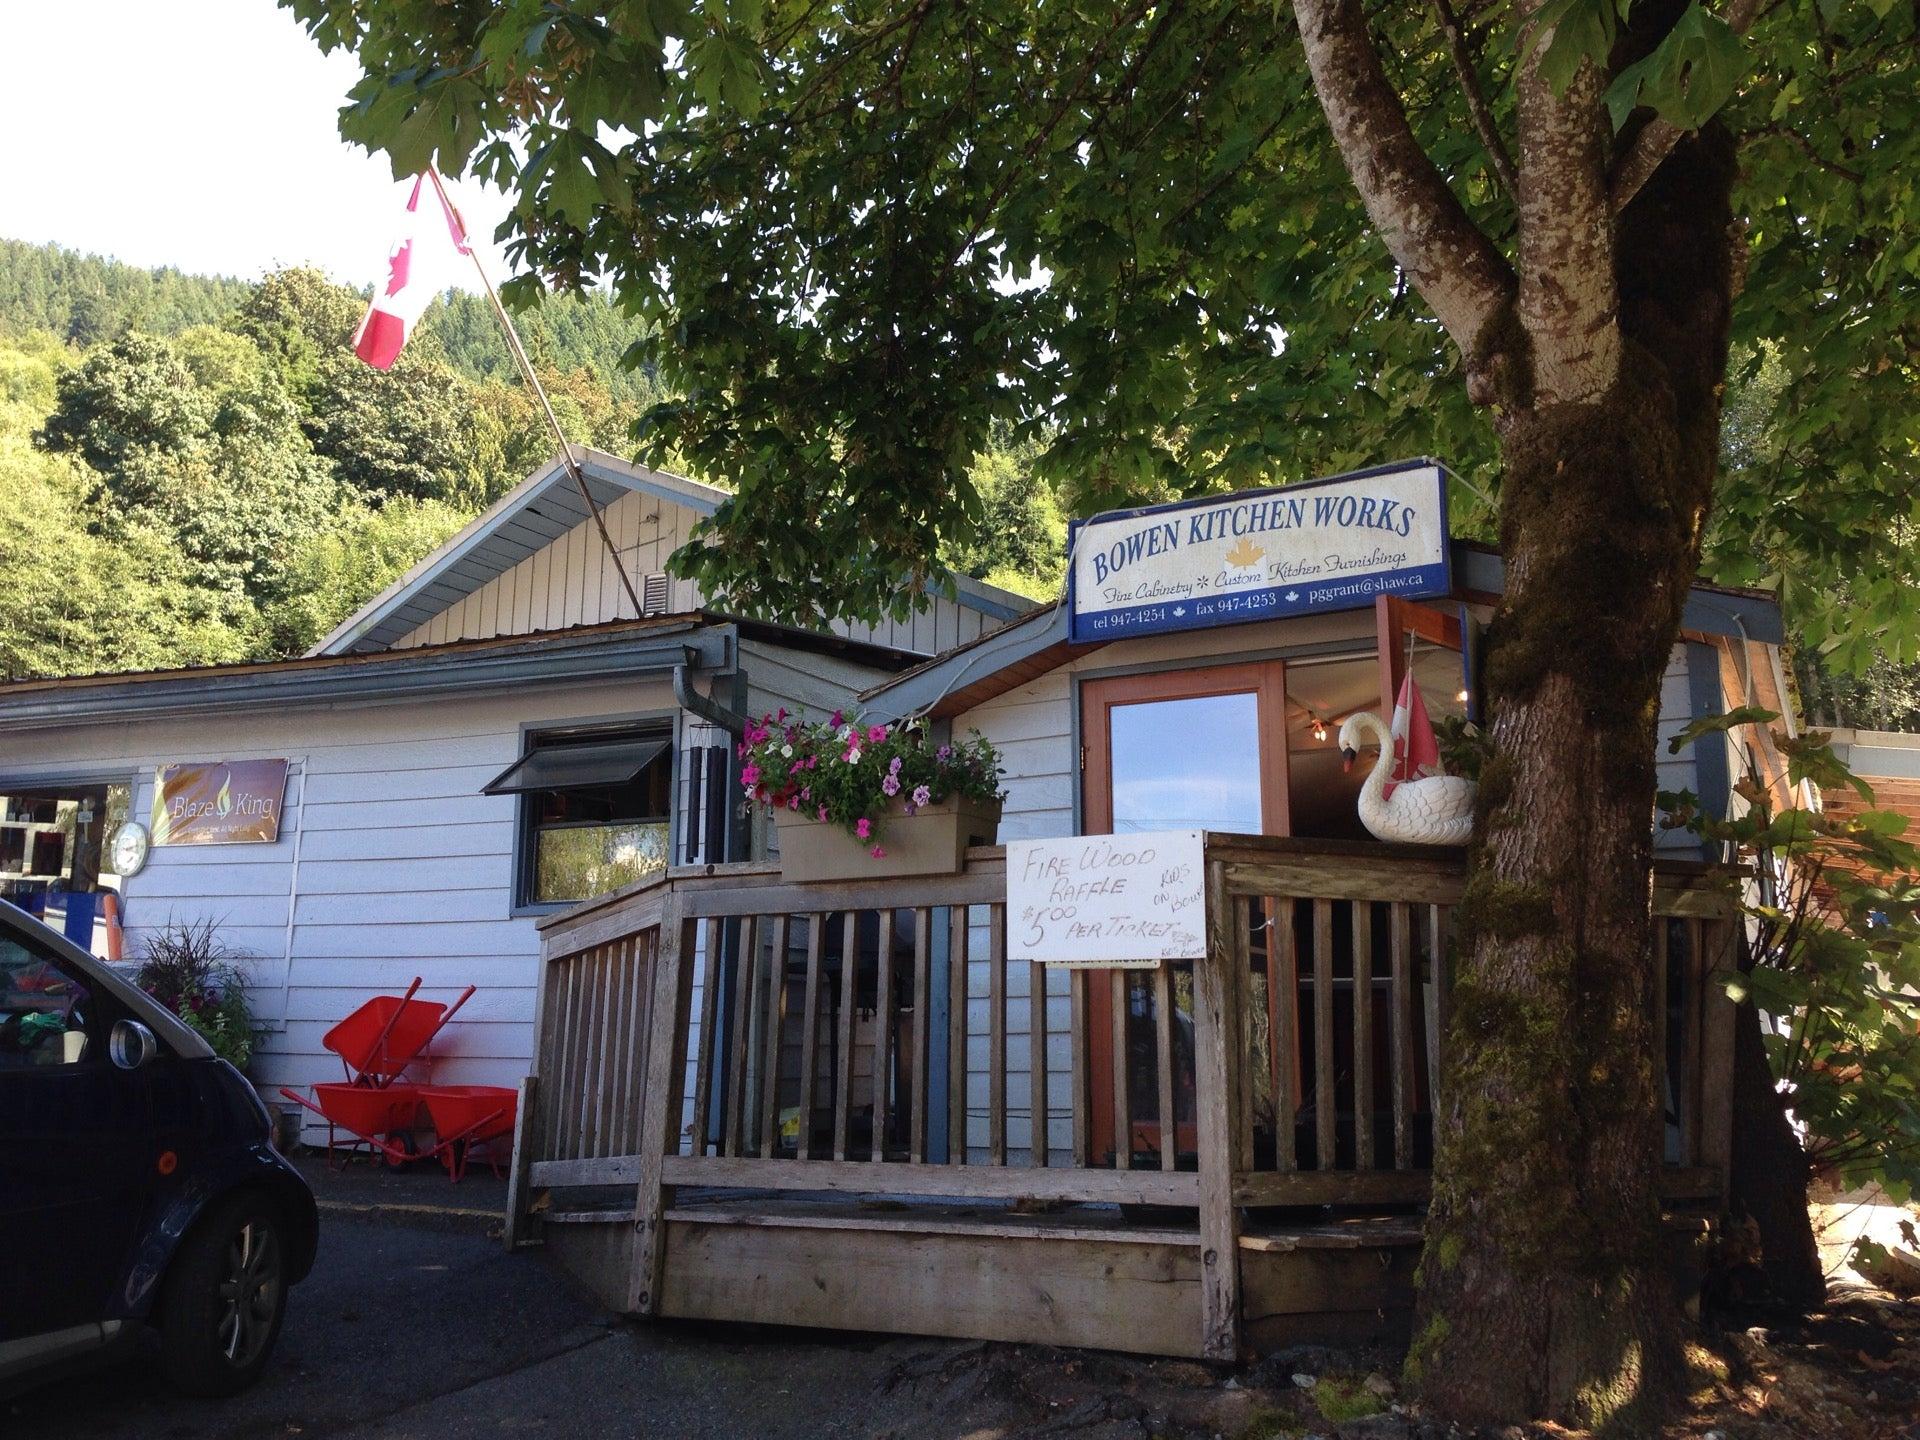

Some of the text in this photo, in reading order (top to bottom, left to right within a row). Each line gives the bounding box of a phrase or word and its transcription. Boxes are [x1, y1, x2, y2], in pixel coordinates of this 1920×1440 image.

[1092, 495, 1417, 586] BOWEN KITCHEN WORKS
[1103, 547, 1408, 604] Fine Cabinetry Custom Kitchen Furnishings
[1093, 574, 1424, 629] tel 947-4254 fax 947-4253 pggrant@shaw.ca
[173, 792, 274, 819] Blaze King
[1023, 846, 1156, 882] FIRE WOOD
[1049, 877, 1128, 903] RAFFLE
[1153, 892, 1170, 906] ON
[1065, 916, 1180, 940] PER TICKET
